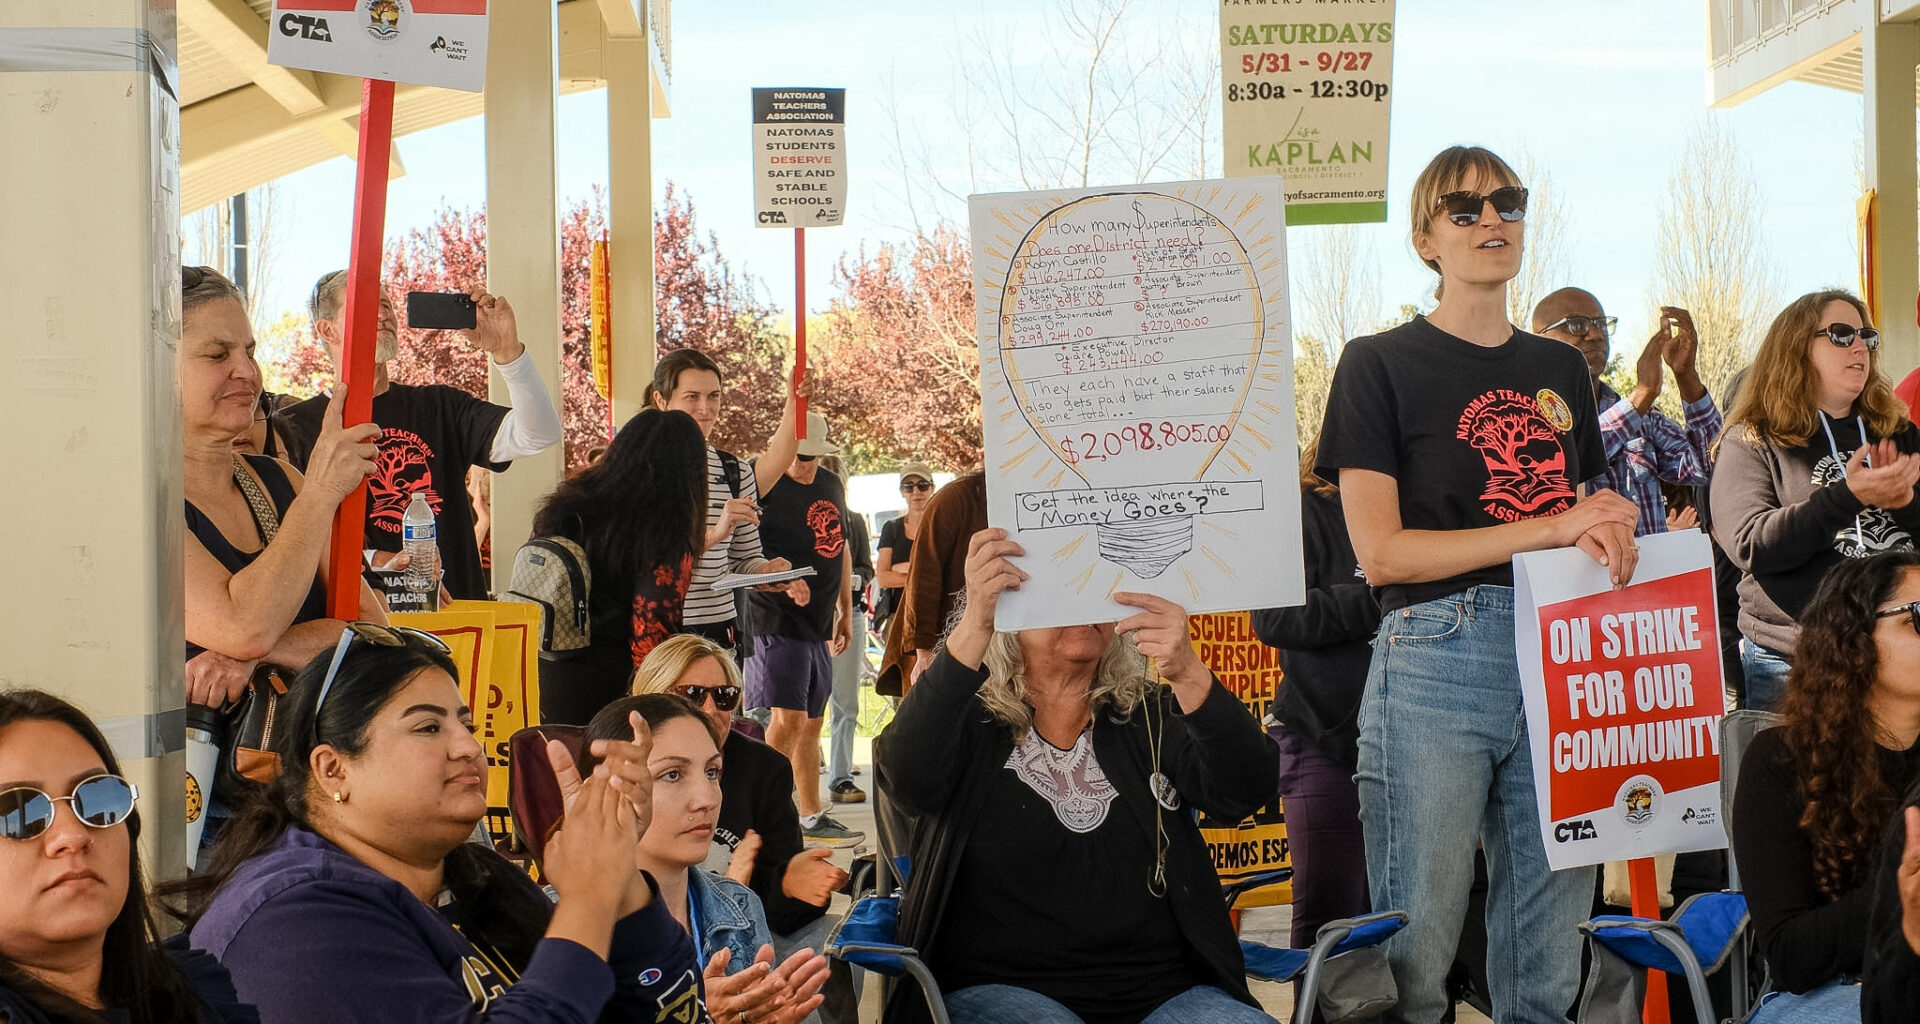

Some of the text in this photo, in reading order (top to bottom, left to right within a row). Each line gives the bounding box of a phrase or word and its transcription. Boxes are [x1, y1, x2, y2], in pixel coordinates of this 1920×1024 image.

[279, 12, 333, 43] CTA
[1228, 22, 1392, 46] SATURDAYS
[446, 46, 469, 55] CAN'T
[451, 39, 465, 47] WE
[446, 53, 467, 61] WAIT
[1241, 52, 1292, 76] 5/31
[1317, 50, 1373, 74] 9/27
[774, 92, 826, 100] NATOMAS
[1228, 81, 1286, 102] 8:30a
[1310, 79, 1389, 102] 12:30p
[772, 102, 827, 110] TEACHERS
[766, 113, 834, 121] ASSOCIATION
[767, 128, 834, 137] NATOMAS
[766, 142, 836, 151] STUDENTS
[1248, 141, 1372, 168] KAPLAN
[770, 156, 832, 164] DESERVE
[767, 169, 835, 178] SAFE AND
[776, 183, 828, 191] STABLE
[771, 197, 833, 205] SCHOOLS
[758, 211, 787, 224] CTA
[1048, 212, 1086, 236] How
[1092, 219, 1132, 236] many
[1026, 226, 1205, 258] Does one District need?
[1023, 255, 1061, 274] Robyn
[1063, 251, 1107, 266] Castillo
[1185, 267, 1242, 279] Superintendent
[1020, 285, 1056, 297] Deputy
[1060, 281, 1127, 294] Superintendent
[1176, 279, 1203, 288] Brown
[1145, 298, 1183, 309] Associate
[1185, 293, 1243, 306] Superintendent
[1012, 314, 1052, 324] Associate
[1055, 309, 1114, 321] Superintendent
[1145, 306, 1196, 320] Rick Messer
[1013, 323, 1042, 335] Doug
[1141, 316, 1209, 334] $270,190.00
[1071, 335, 1175, 352] Executive Director
[1098, 346, 1134, 357] Powell
[1025, 363, 1248, 400] They each have a staff that
[1025, 382, 1235, 414] also gets paid but their salaries
[1037, 412, 1071, 424] alone
[1456, 390, 1497, 441] NATOMAS
[1060, 421, 1230, 468] $2,098,805.00
[1811, 450, 1847, 486] NATOMS
[1022, 483, 1231, 512] Get the idea where the
[1040, 507, 1112, 528] Money
[1550, 605, 1702, 665] ON STRIKE
[1567, 663, 1695, 720] FOR OUR
[1553, 714, 1722, 773] COMMUNITY
[1696, 812, 1716, 820] CAN'T
[1697, 818, 1716, 826] WAIT
[1554, 819, 1598, 843] CTA
